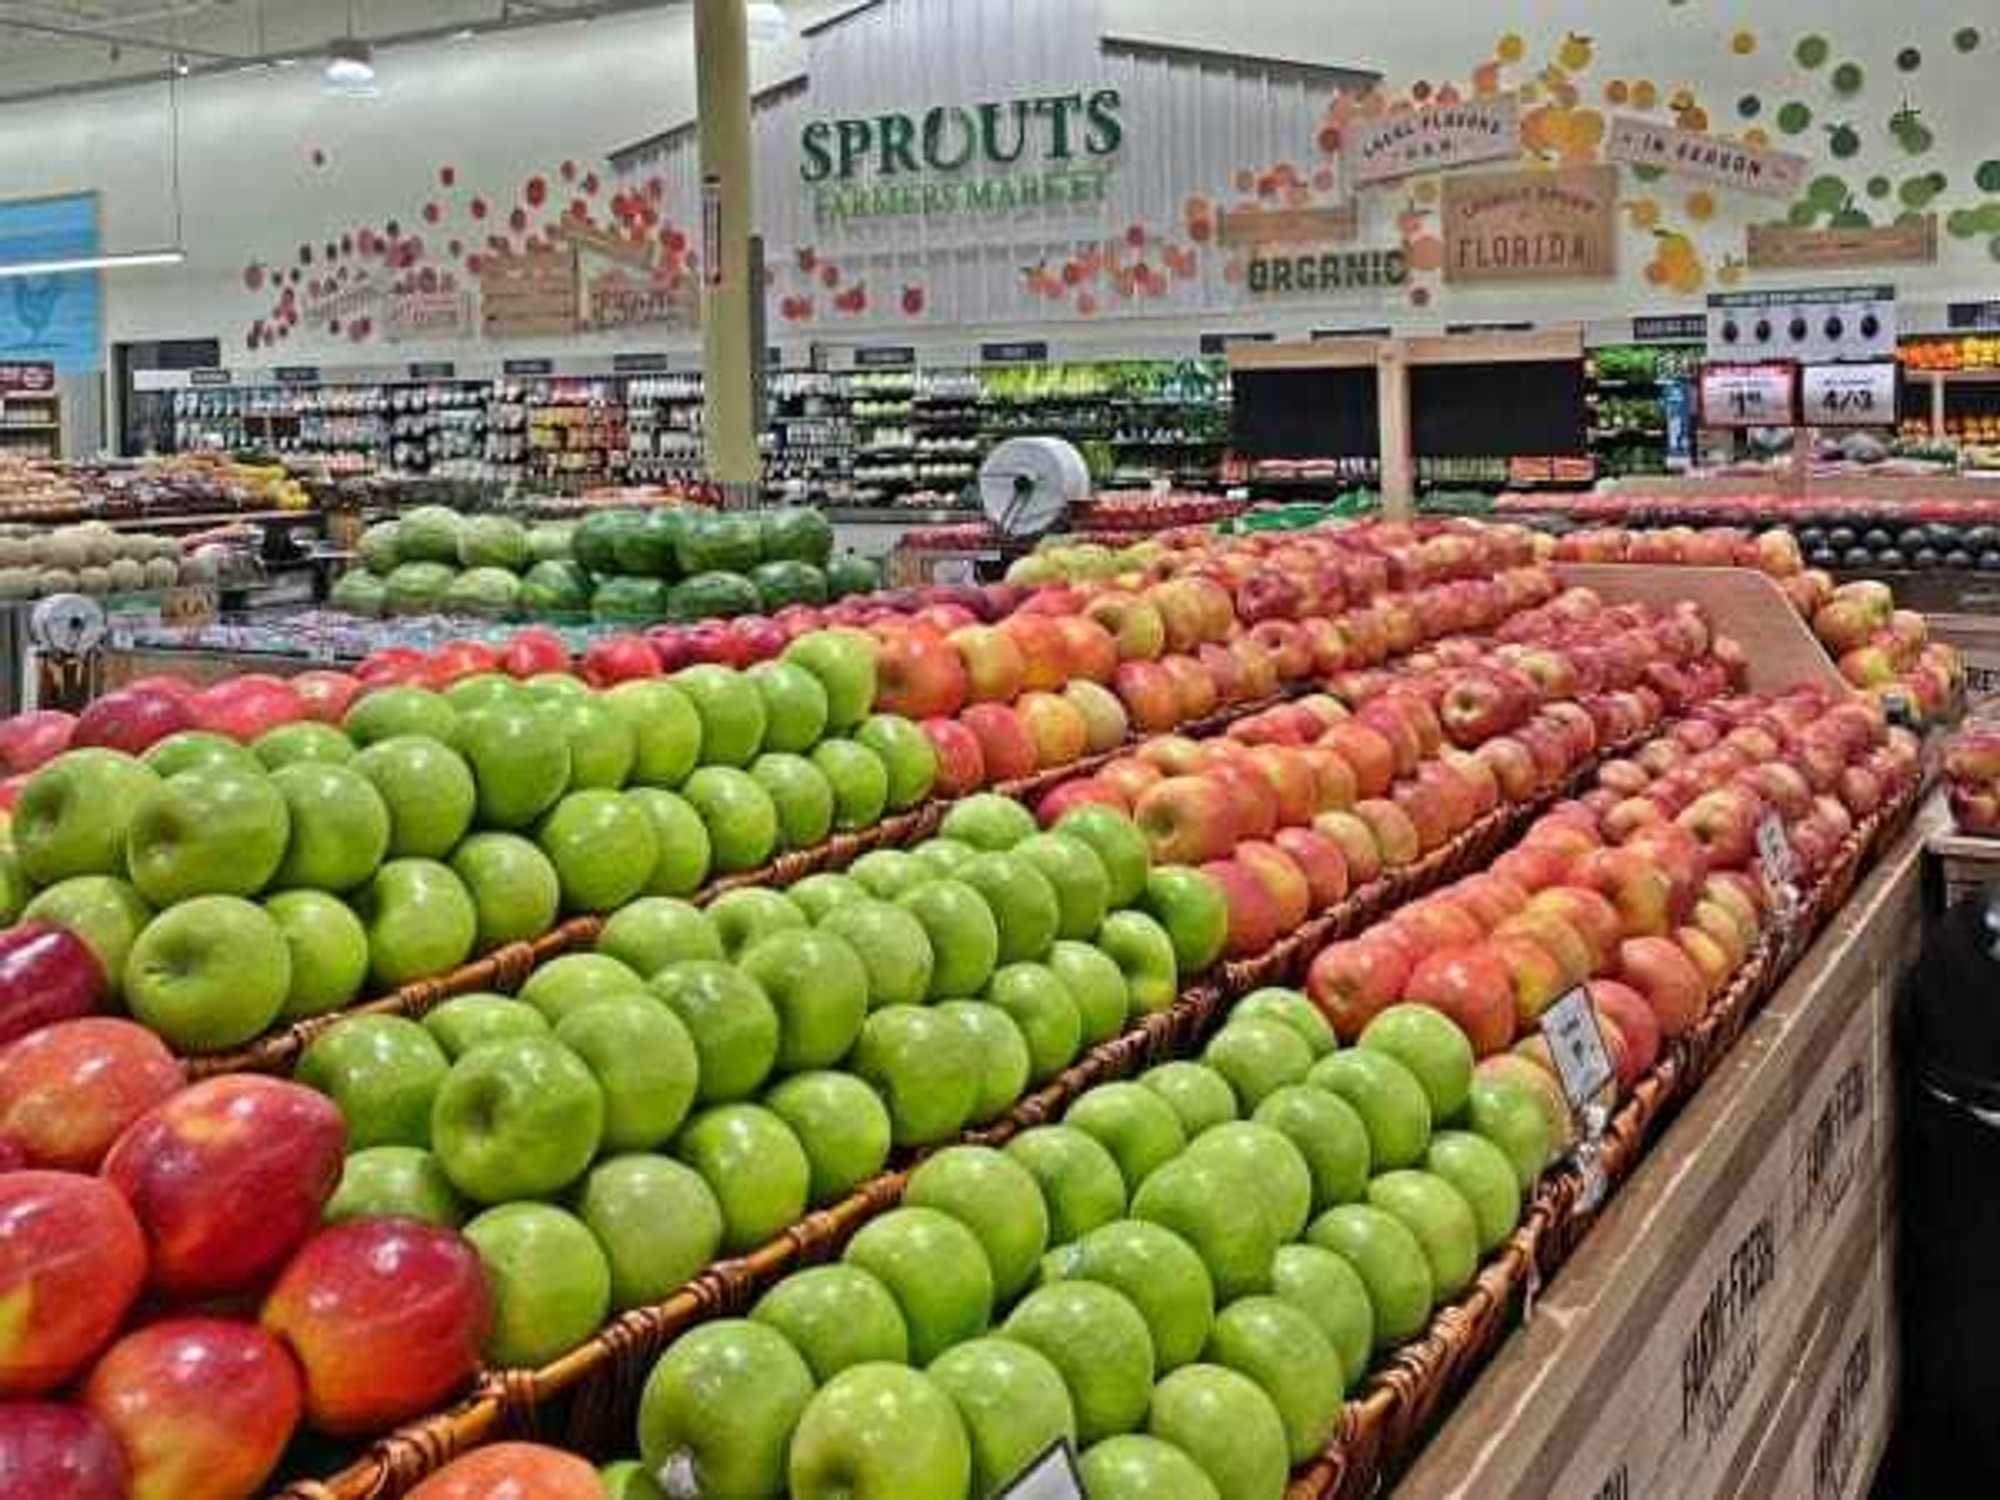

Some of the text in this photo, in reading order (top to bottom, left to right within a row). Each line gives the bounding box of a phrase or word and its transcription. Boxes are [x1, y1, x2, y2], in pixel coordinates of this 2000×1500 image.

[800, 89, 1122, 181] SPROUTS
[815, 170, 1106, 220] FARMERS MARKET
[1248, 249, 1409, 293] ORGANIC
[1458, 233, 1590, 269] FLORIDA
